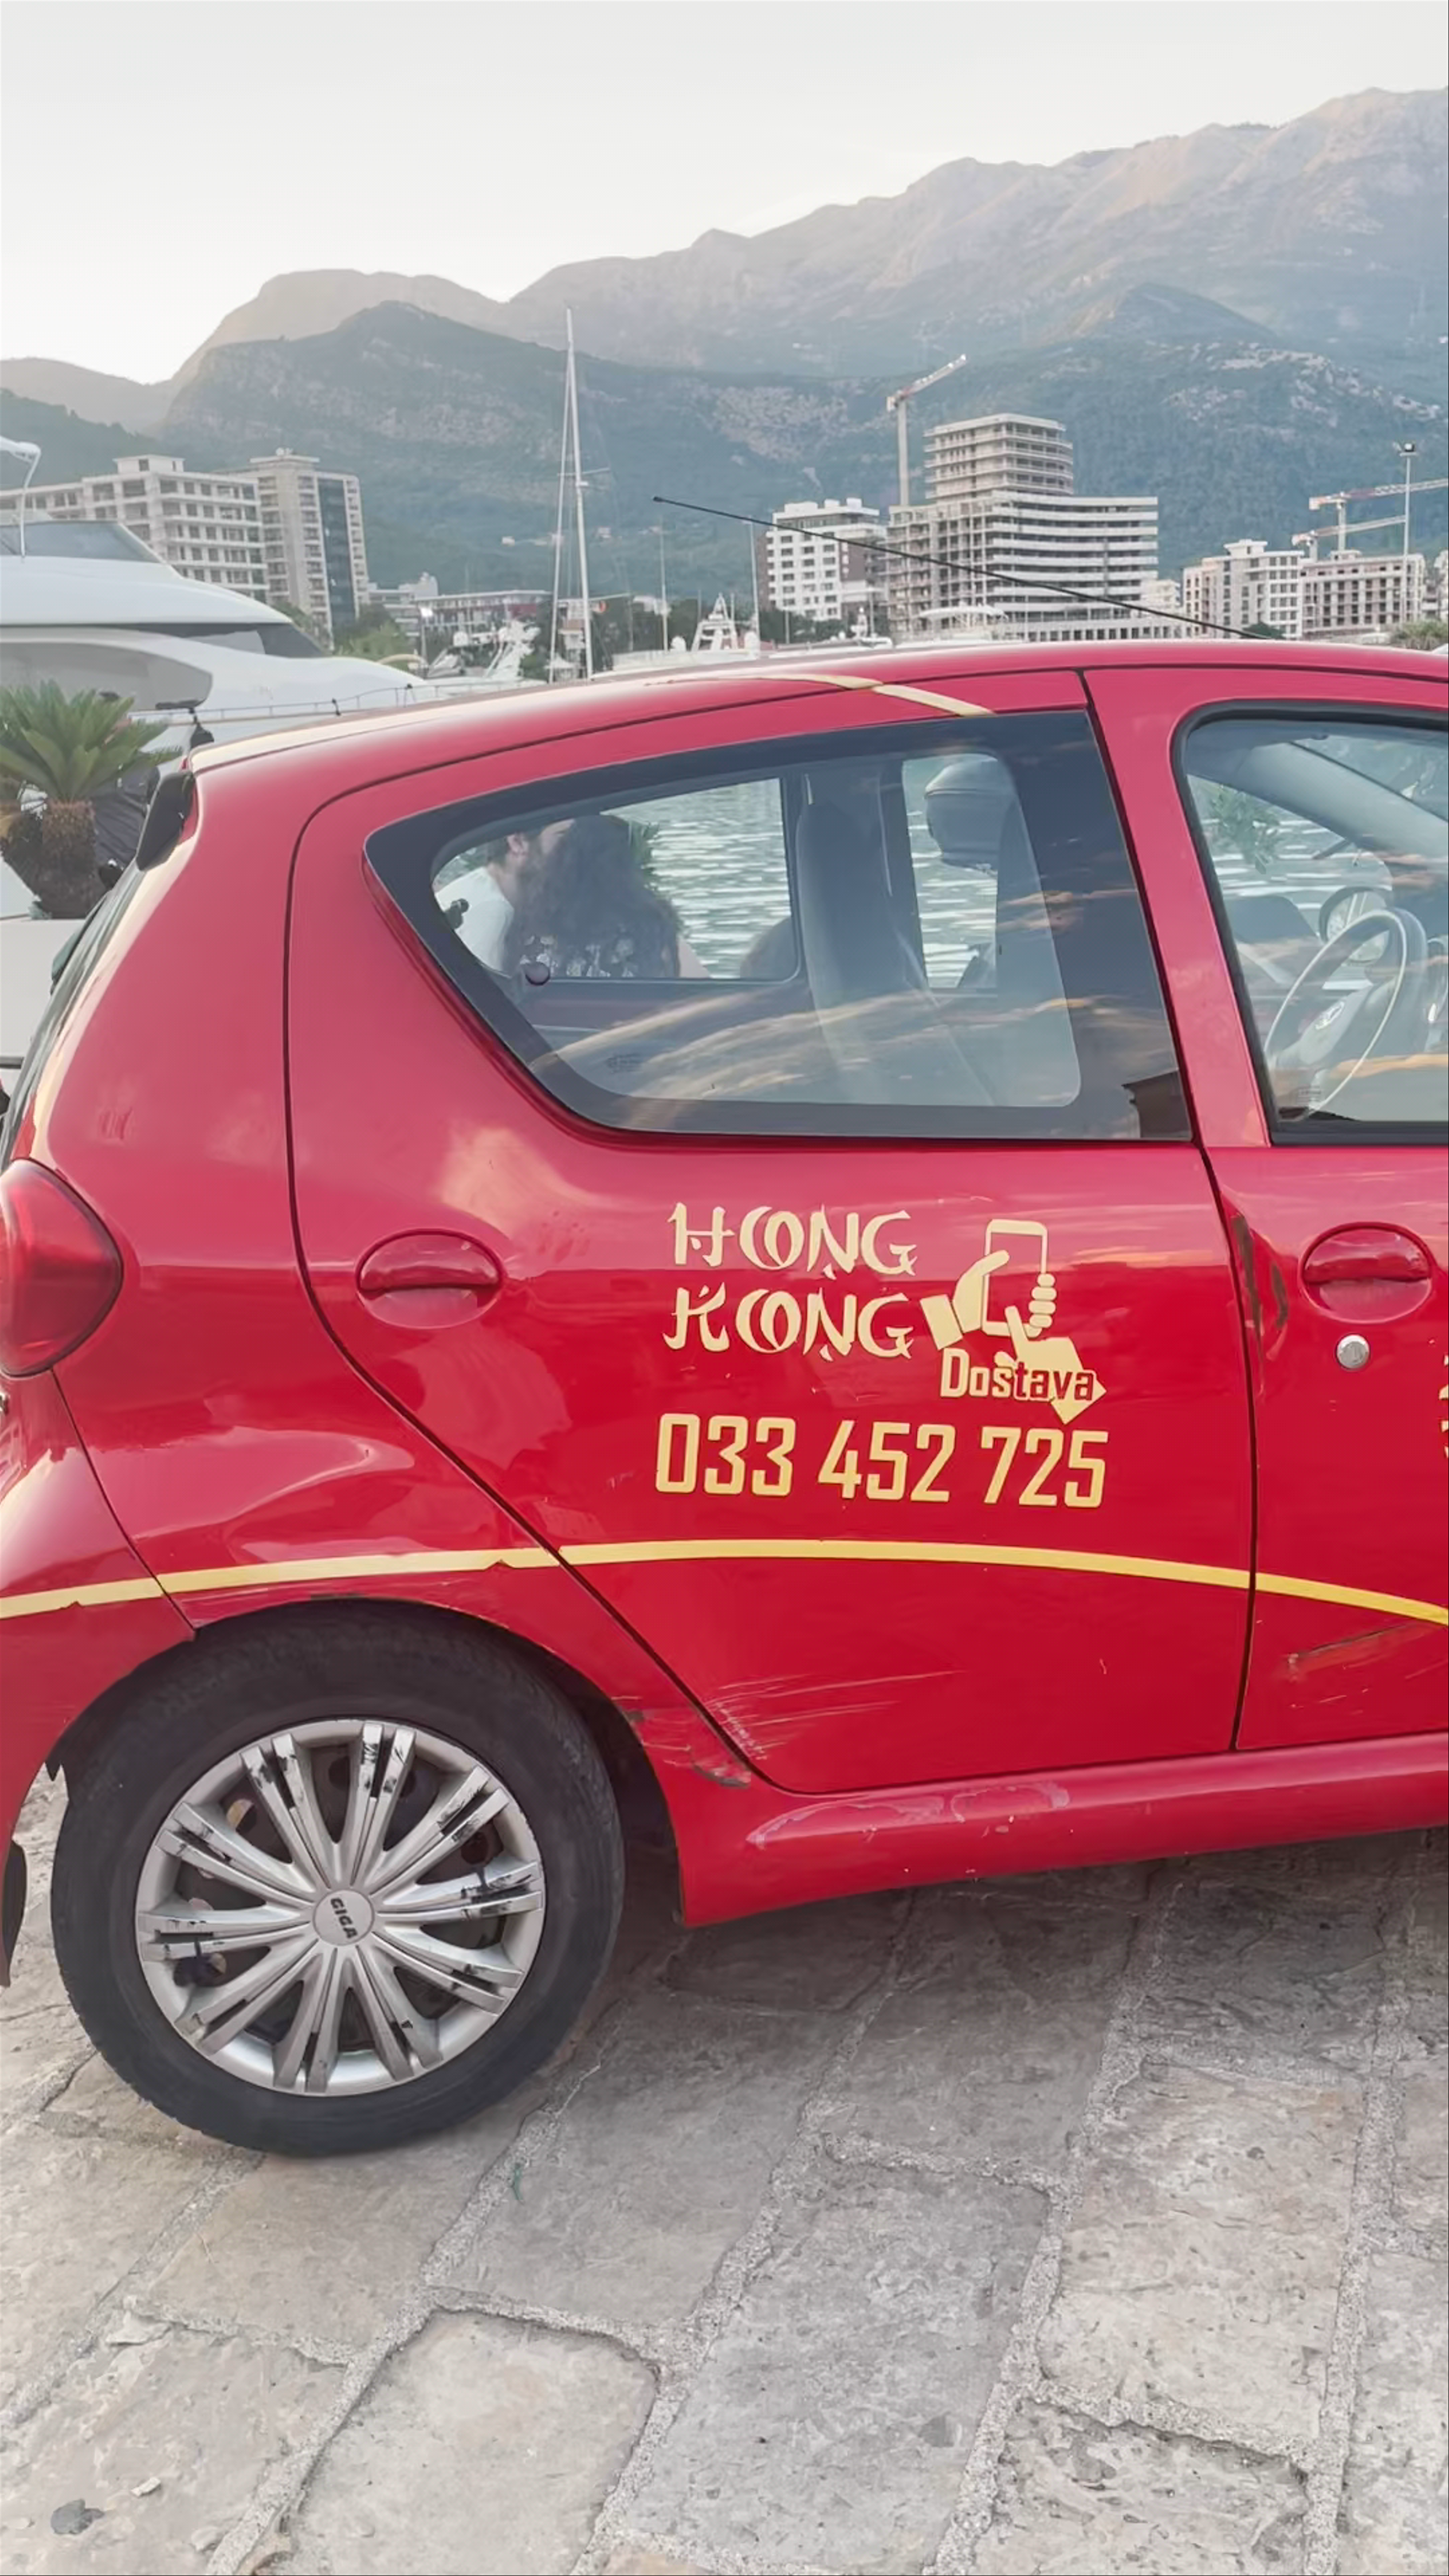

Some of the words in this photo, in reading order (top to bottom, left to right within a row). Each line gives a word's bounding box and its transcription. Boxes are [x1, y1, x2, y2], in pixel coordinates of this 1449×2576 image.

[667, 1202, 918, 1280] HONG
[663, 1282, 914, 1361] KONG
[940, 1347, 1097, 1401] Dostava
[655, 1413, 796, 1496] 033
[818, 1420, 956, 1502] 452
[981, 1426, 1108, 1507] 725
[331, 1897, 357, 1938] GIGA
